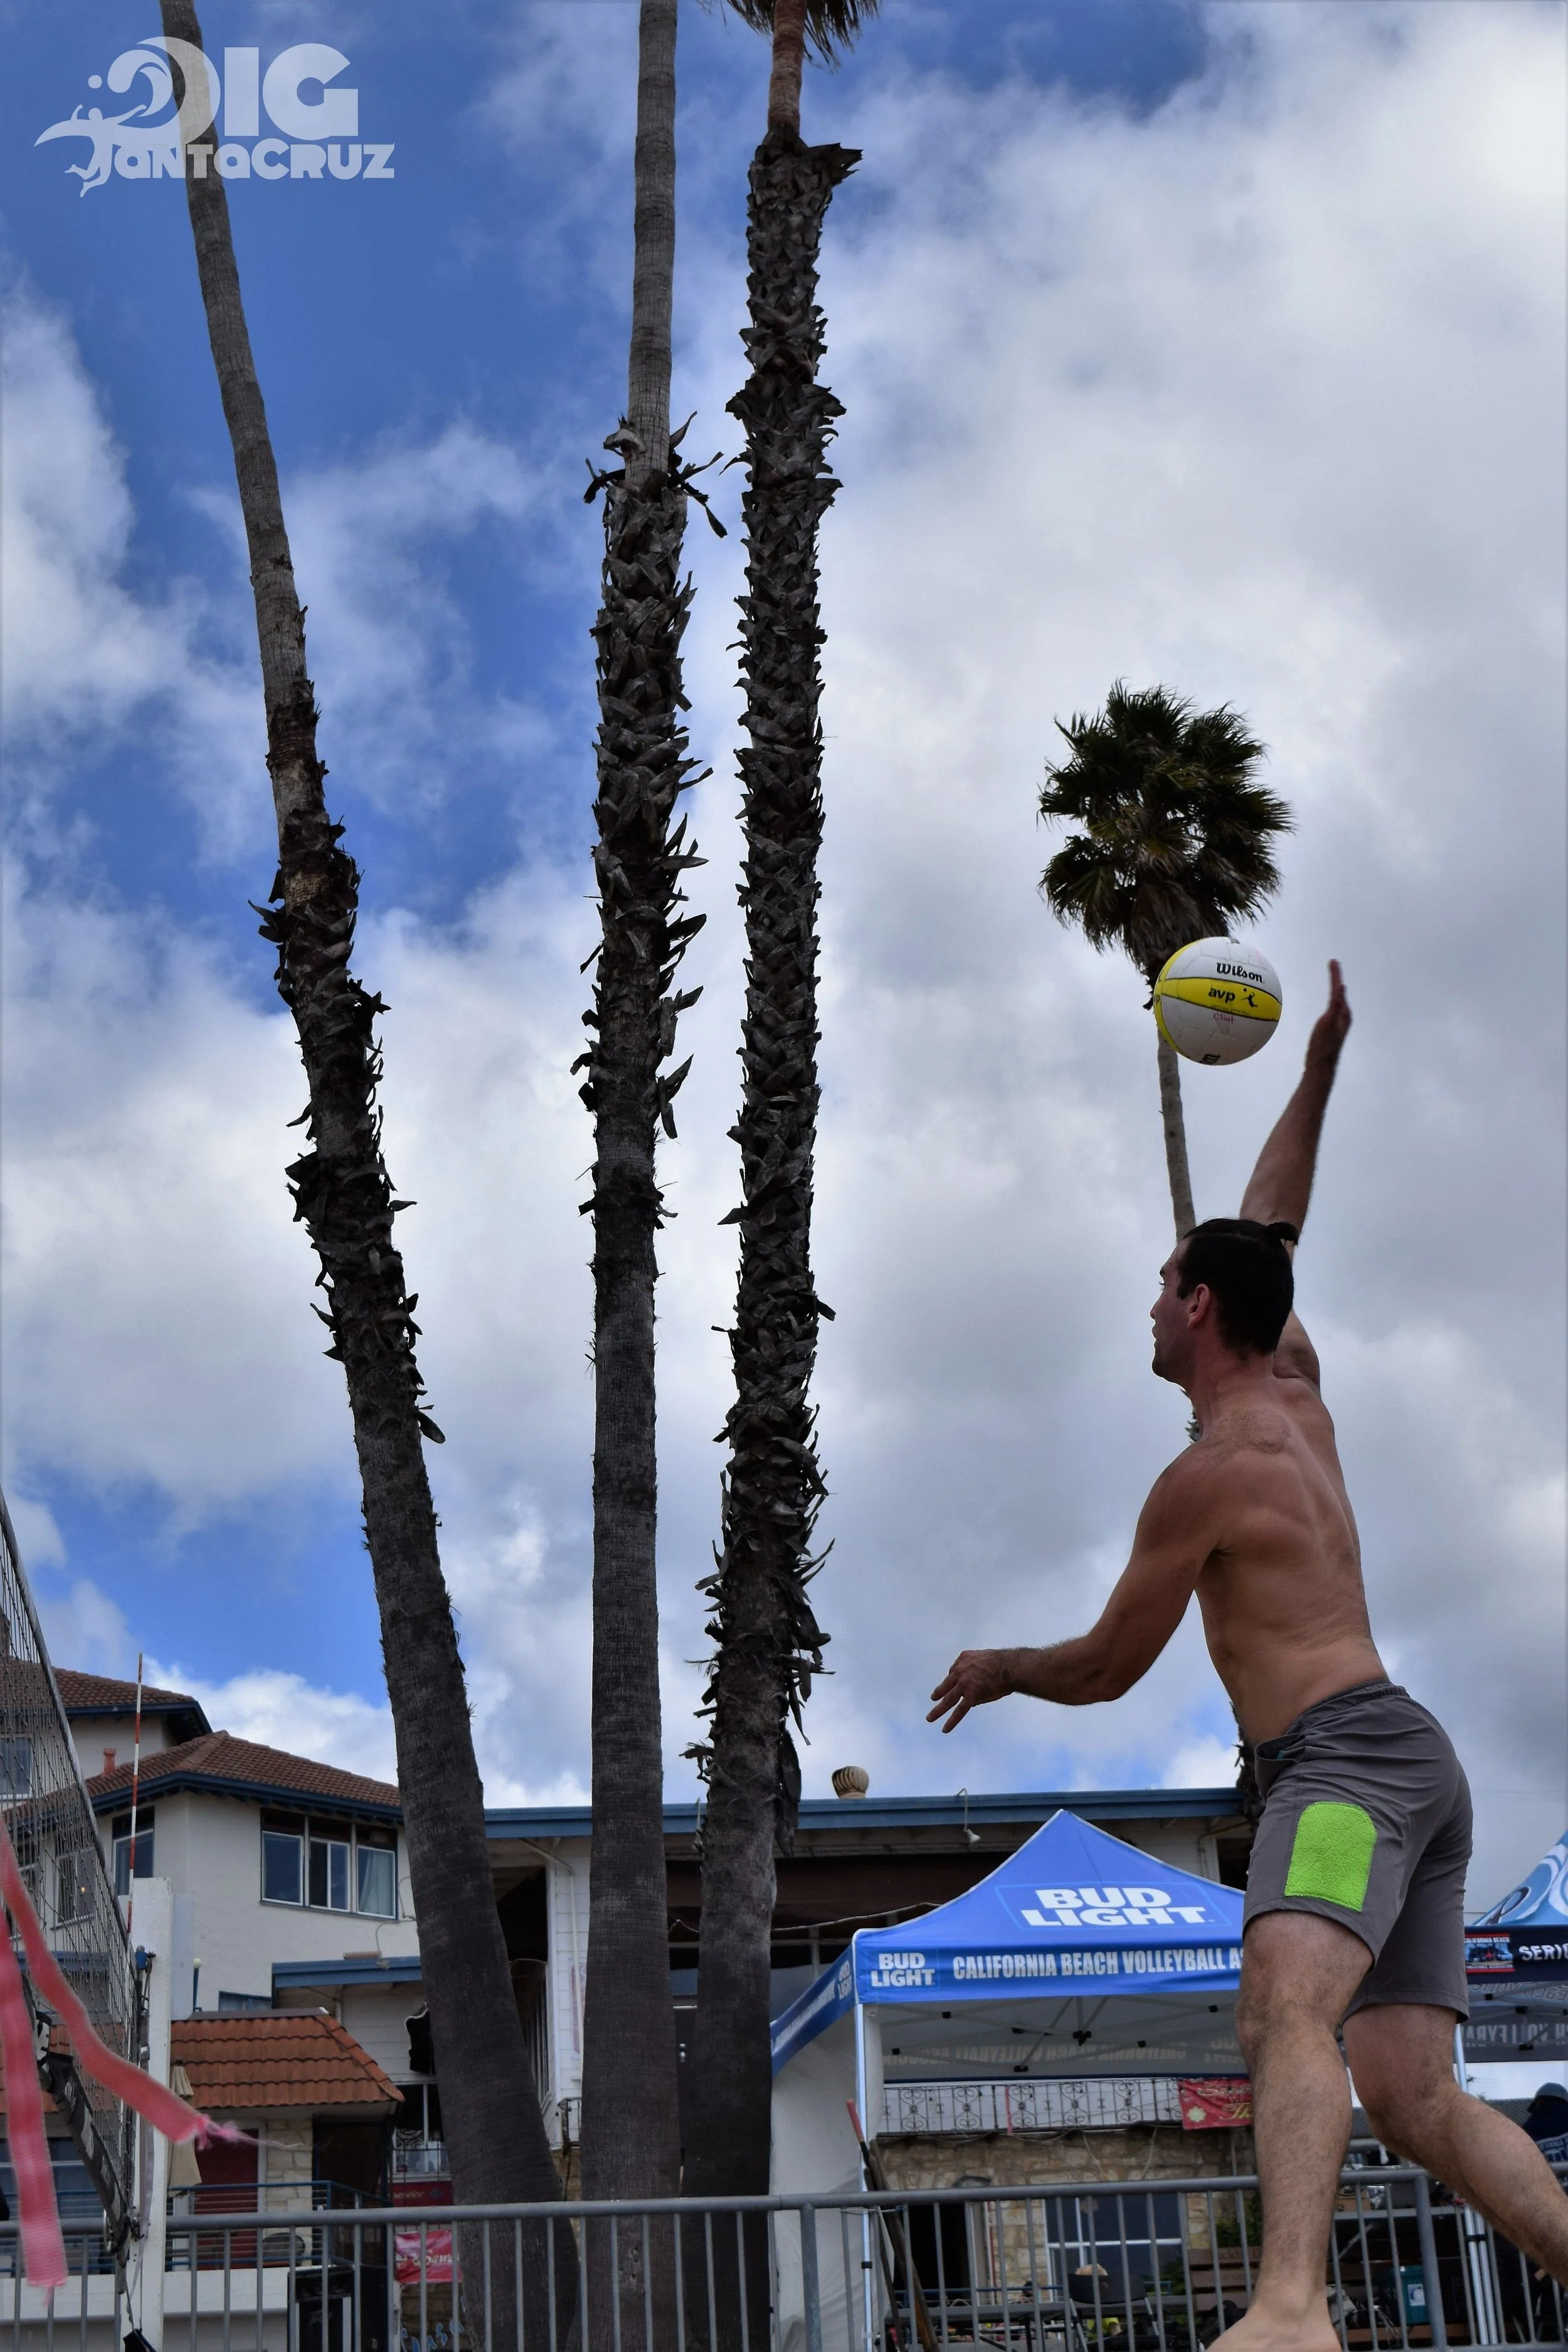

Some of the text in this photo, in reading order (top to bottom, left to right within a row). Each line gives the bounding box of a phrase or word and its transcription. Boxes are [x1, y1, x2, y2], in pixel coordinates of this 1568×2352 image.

[1216, 963, 1263, 983] Wilson
[1209, 987, 1236, 1004] avp
[1035, 1887, 1172, 1909] BUD
[1020, 1907, 1206, 1927] LIGHT
[878, 1952, 925, 1969] BUD
[953, 1954, 1057, 1980] CALIFORNIA
[1061, 1951, 1118, 1976] BEACH
[1123, 1949, 1226, 1974] VOLLEYBALL
[871, 1969, 935, 1987] LIGHT
